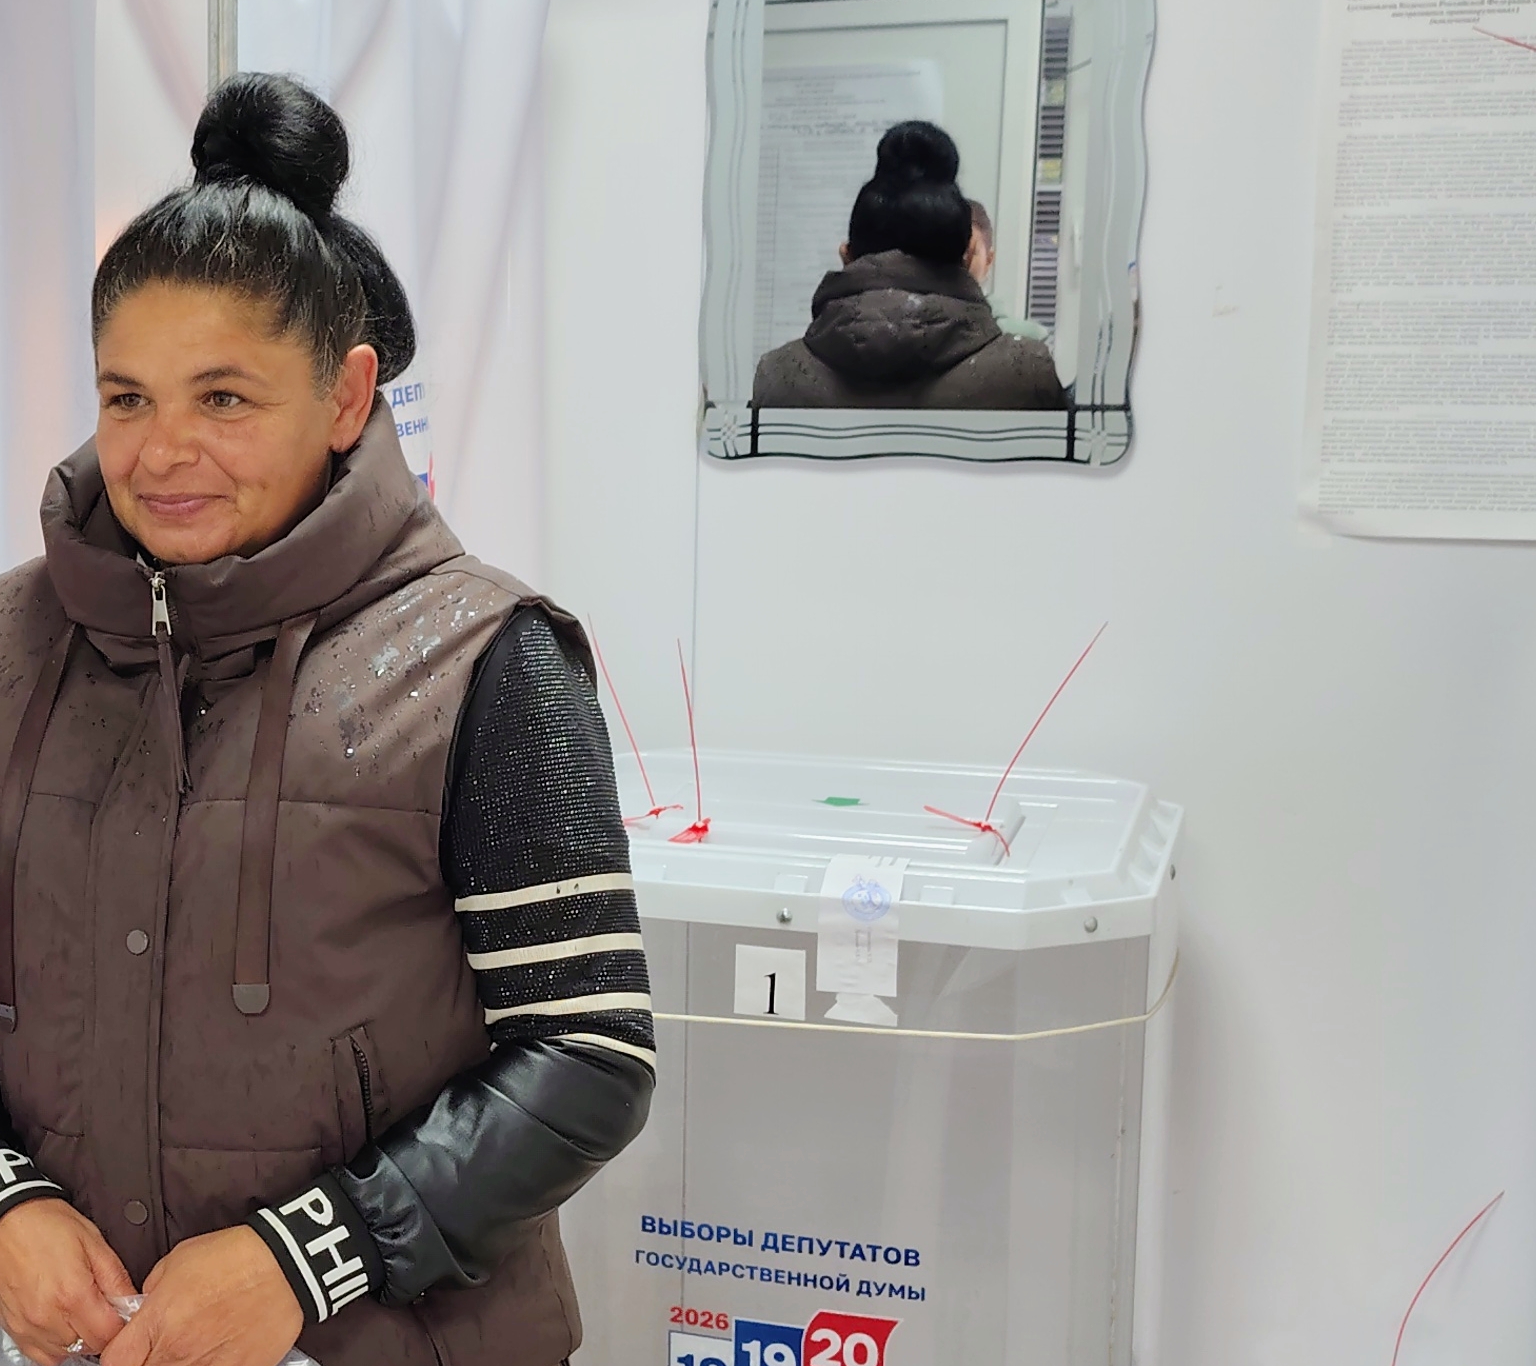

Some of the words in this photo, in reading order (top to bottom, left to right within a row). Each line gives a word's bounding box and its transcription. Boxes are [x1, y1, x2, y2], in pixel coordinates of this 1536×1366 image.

[763, 972, 779, 1015] 1
[641, 1215, 754, 1248] ВЫБОРЫ
[761, 1232, 921, 1267] ДЕПУТАТОВ
[635, 1249, 851, 1293] ГОСУДАРСТВЕННОЙ
[857, 1279, 926, 1301] ДУМЫ
[669, 1306, 729, 1330] 2026
